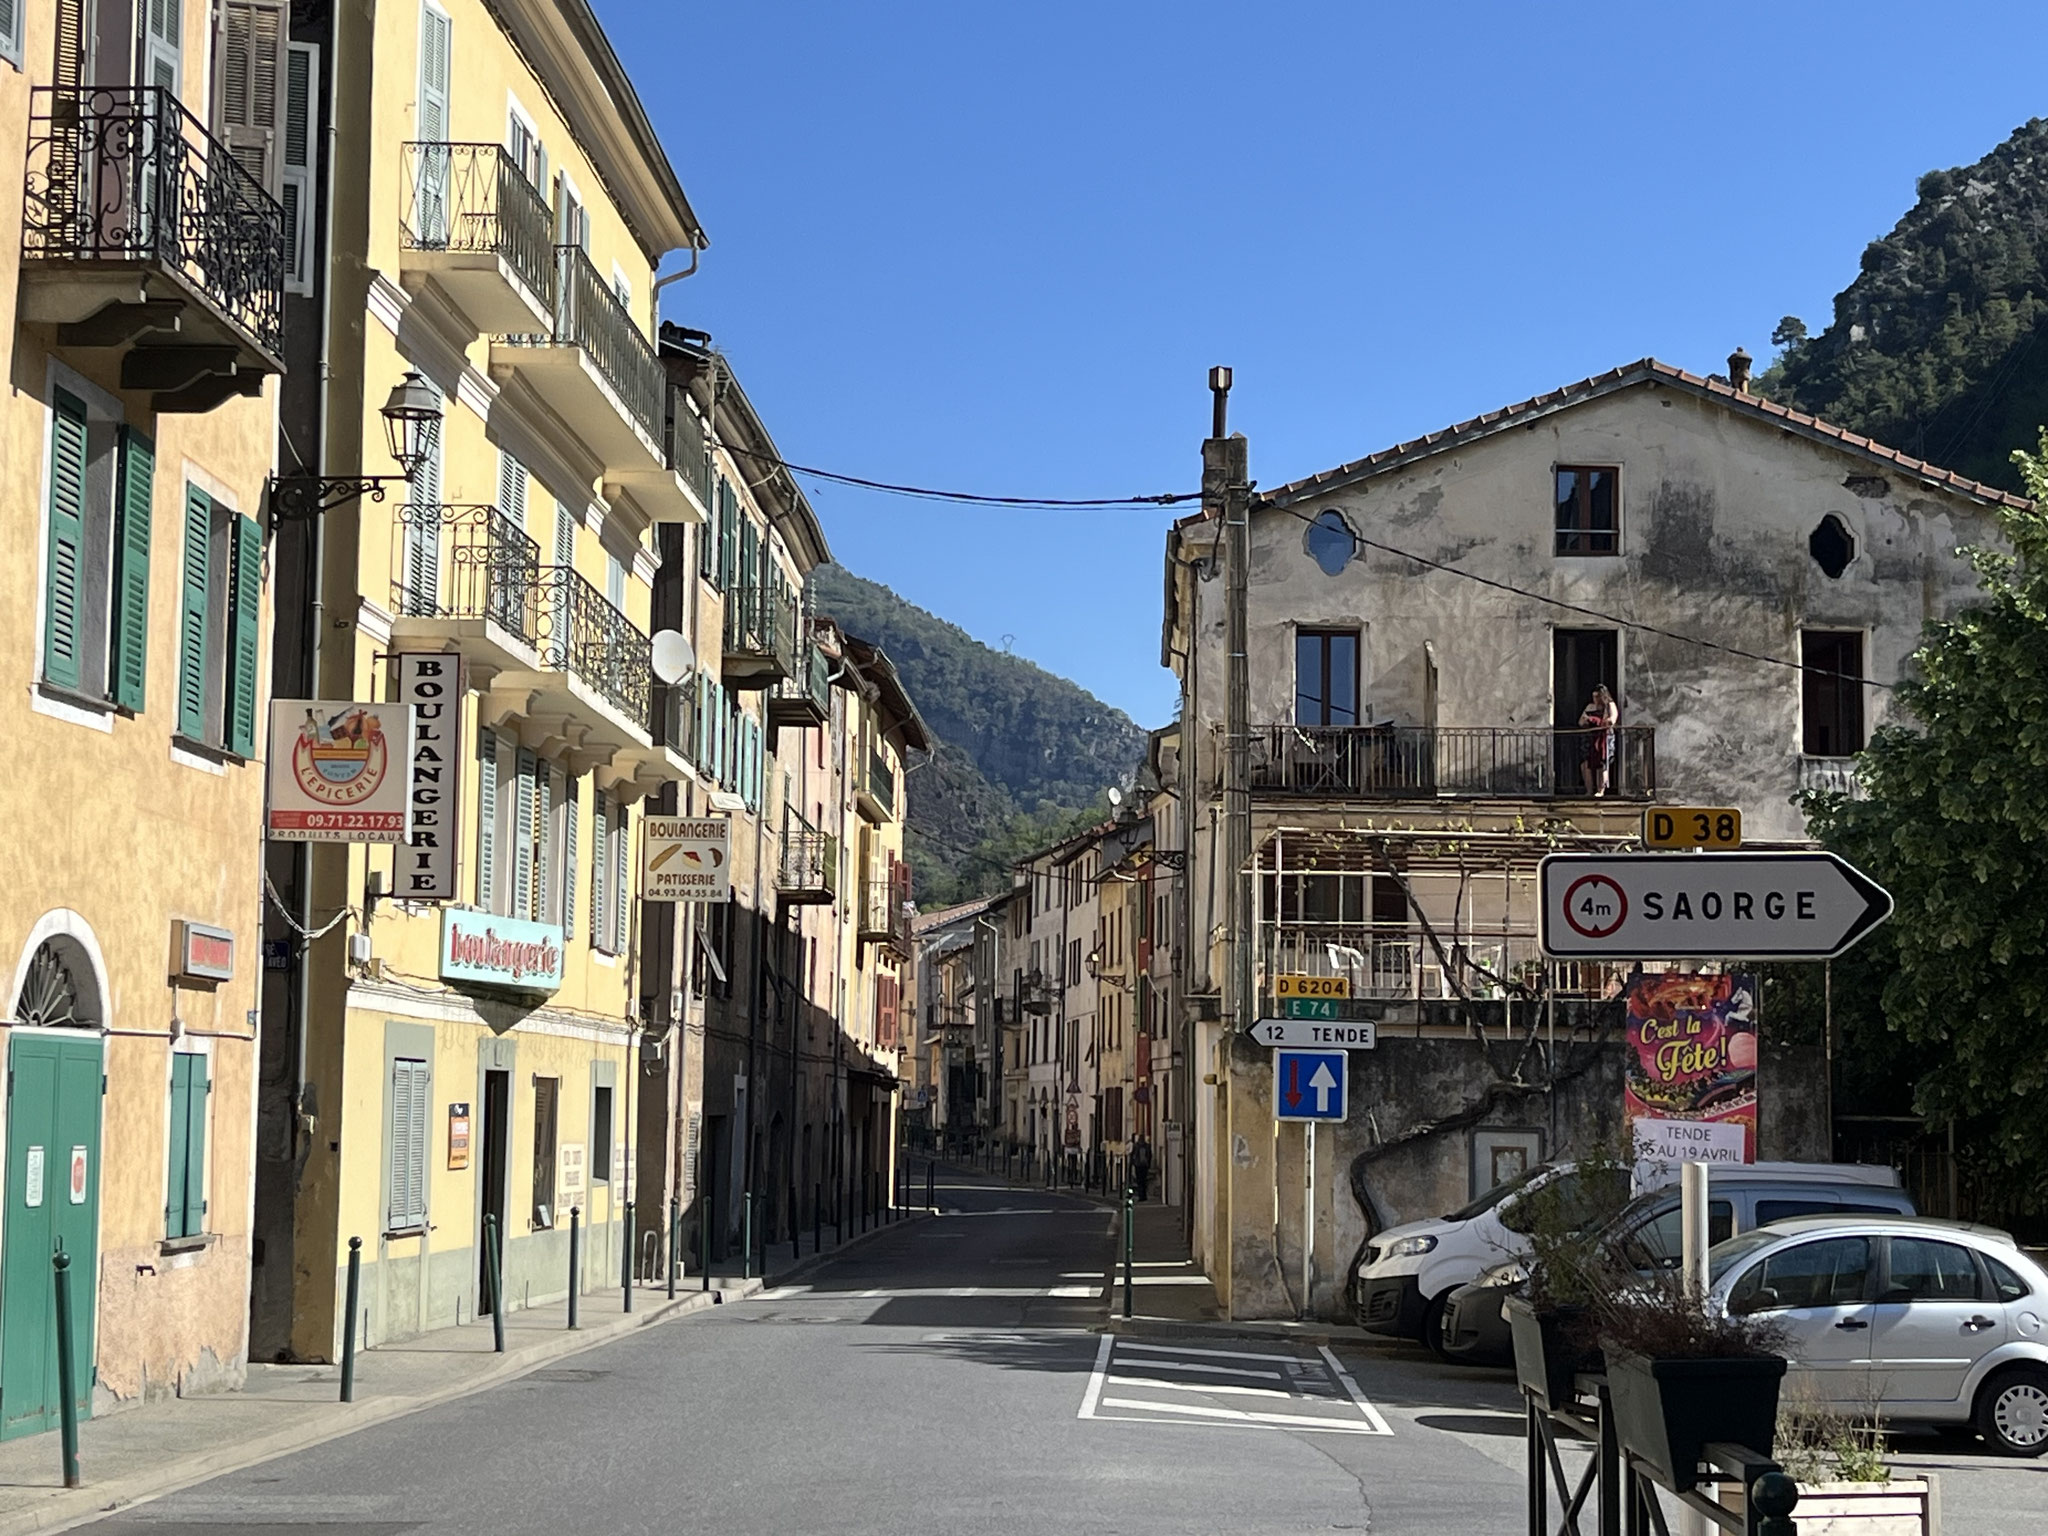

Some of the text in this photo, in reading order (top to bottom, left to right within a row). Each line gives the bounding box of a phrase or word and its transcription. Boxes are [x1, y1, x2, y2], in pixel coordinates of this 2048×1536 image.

[300, 766, 378, 800] L'EPICERIE
[409, 660, 444, 891] BOULANGERIE
[306, 814, 404, 829] 09.71.22.17.93
[649, 822, 726, 838] BOULANGERIE
[1653, 813, 1736, 842] D 38
[348, 831, 405, 841] LOCAUX
[656, 873, 716, 886] PATISSERIE
[1580, 891, 1817, 921] 4m SAORGE
[450, 923, 559, 979] boulangerie
[1279, 980, 1345, 995] D 6204
[1292, 1000, 1331, 1016] E 74
[1266, 1025, 1369, 1043] 12 TENDE
[1640, 1015, 1701, 1044] C'est la
[1666, 1126, 1712, 1142] TENDE
[1656, 1144, 1677, 1158] AU
[1682, 1146, 1697, 1159] 19
[1701, 1147, 1740, 1162] AVRIL
